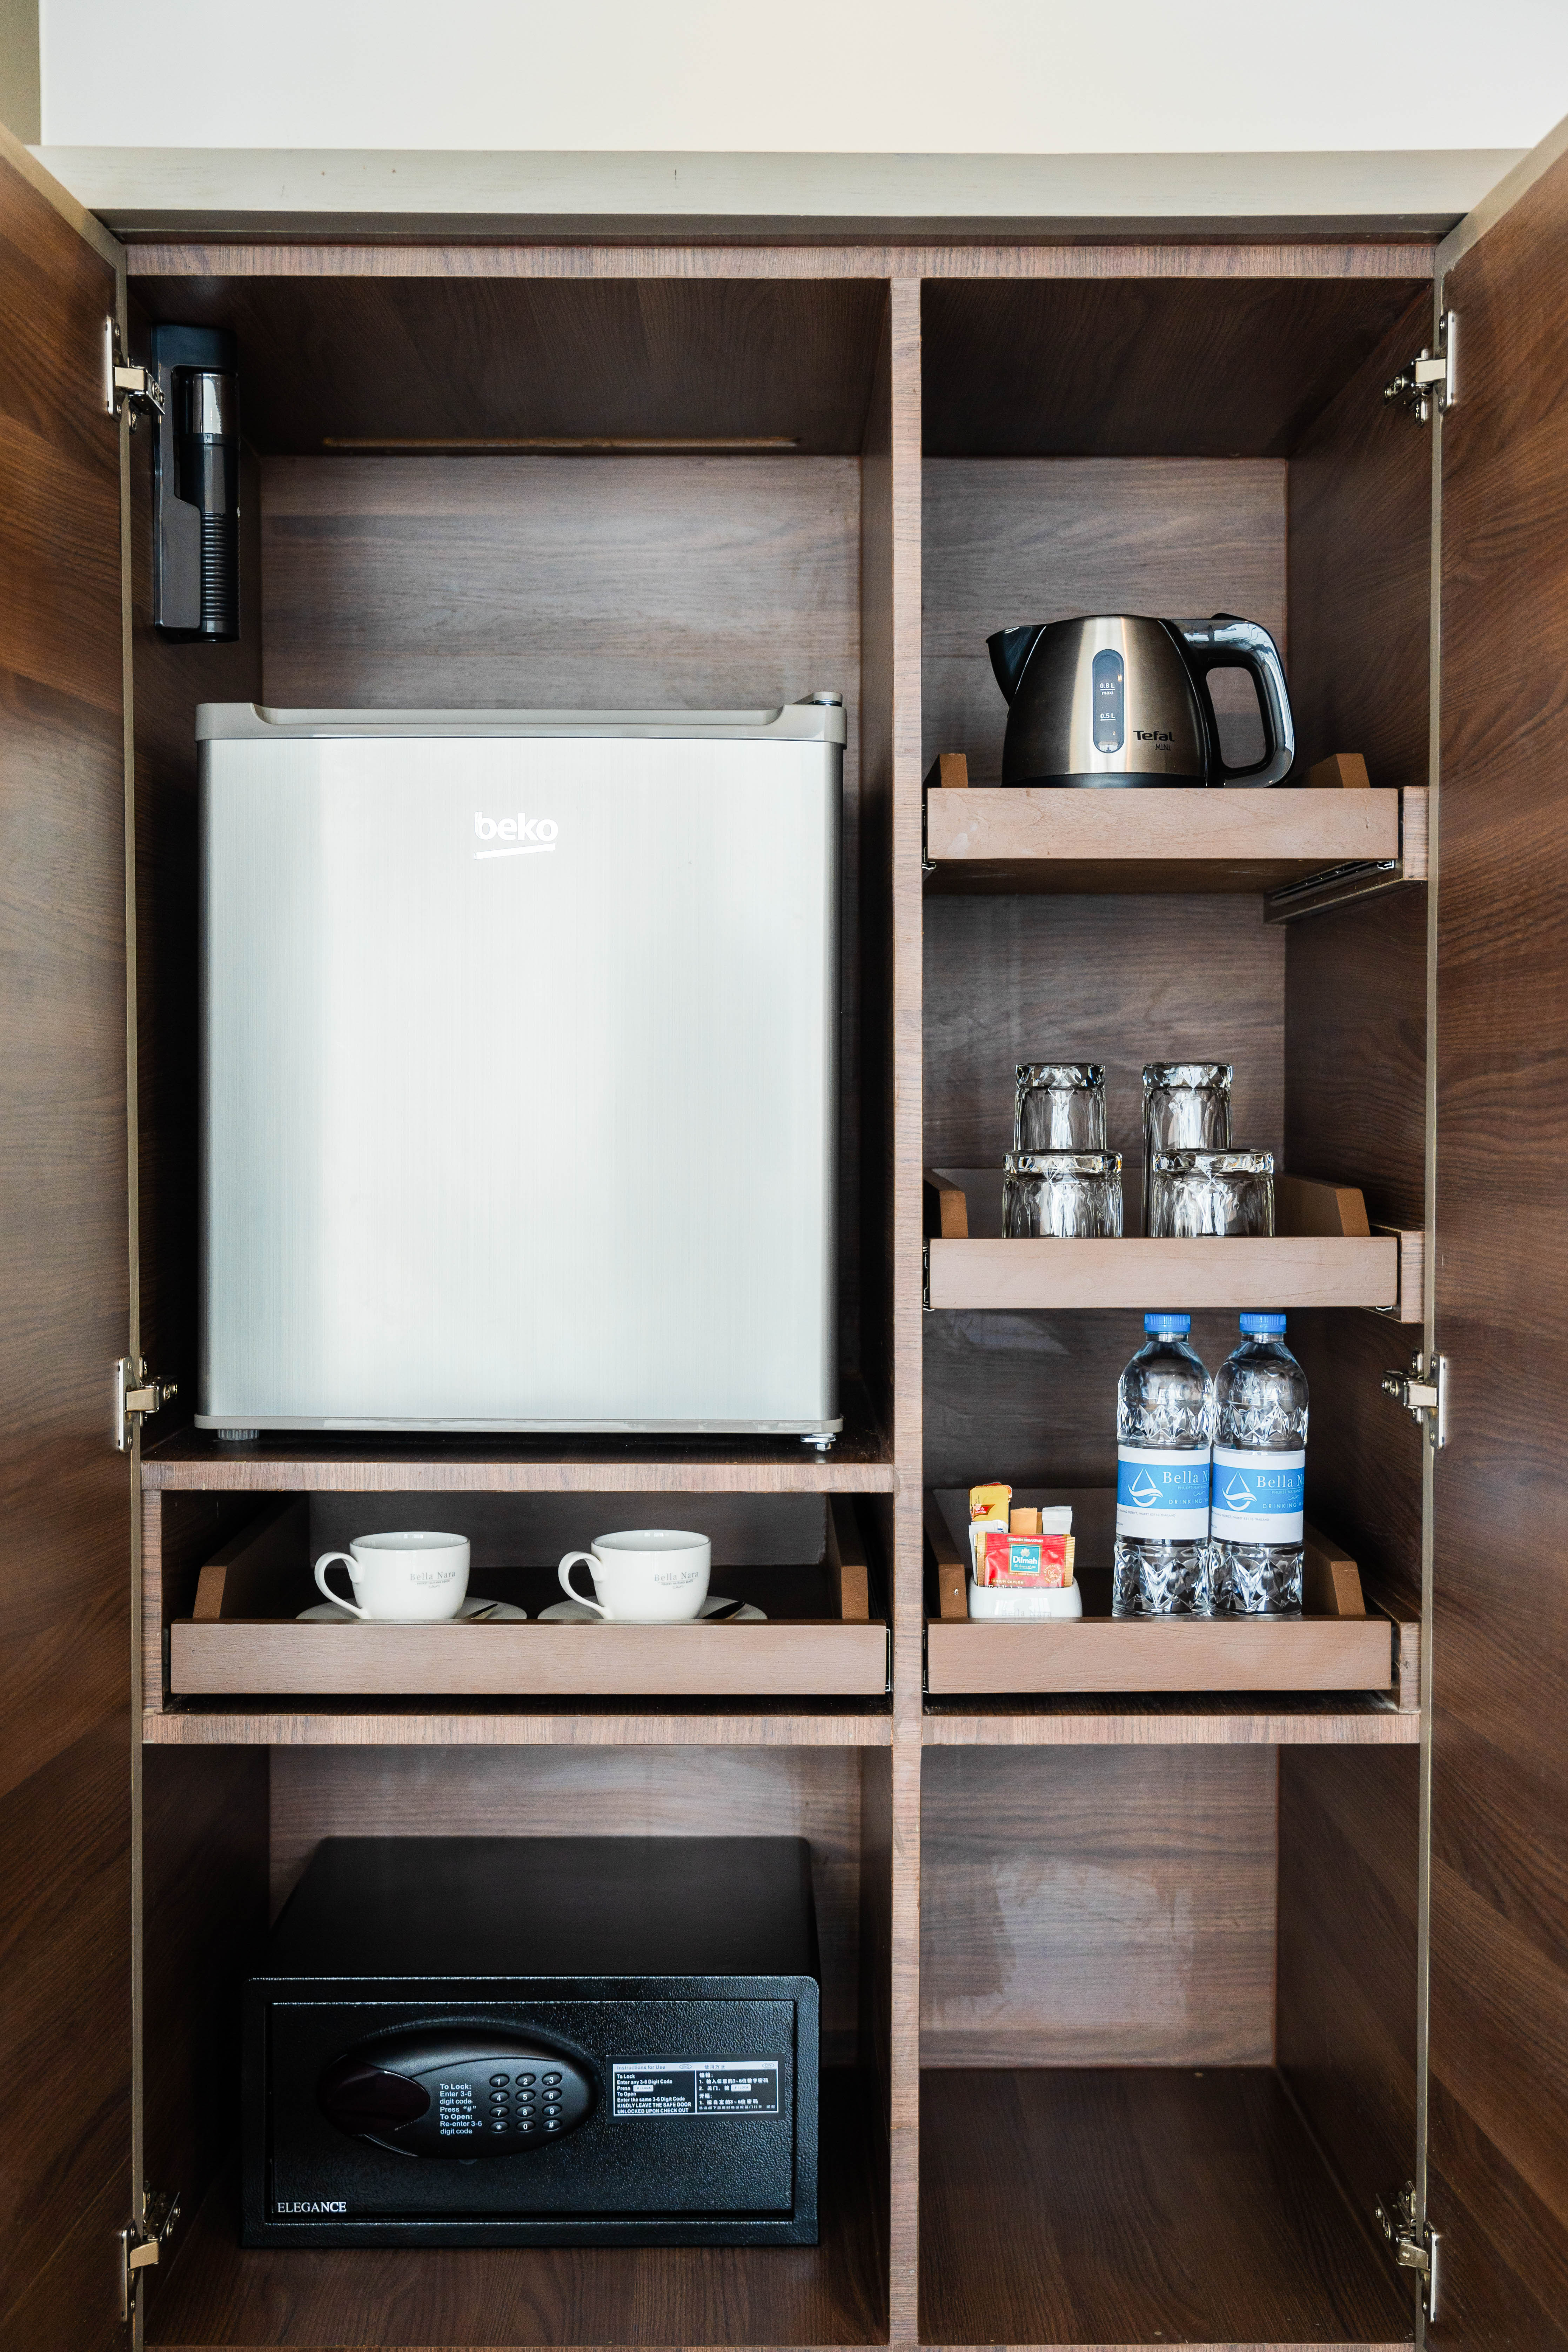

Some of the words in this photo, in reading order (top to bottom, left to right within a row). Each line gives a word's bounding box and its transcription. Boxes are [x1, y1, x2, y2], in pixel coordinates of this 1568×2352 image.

[1133, 730, 1175, 742] Tefal
[475, 811, 558, 842] beko
[1162, 1470, 1199, 1483] Bella
[1257, 1475, 1293, 1488] Bella
[1013, 1556, 1037, 1564] Dilmah
[410, 1572, 433, 1581] Bella
[654, 1573, 677, 1581] Bella
[277, 2202, 347, 2213] ELEGANCE
